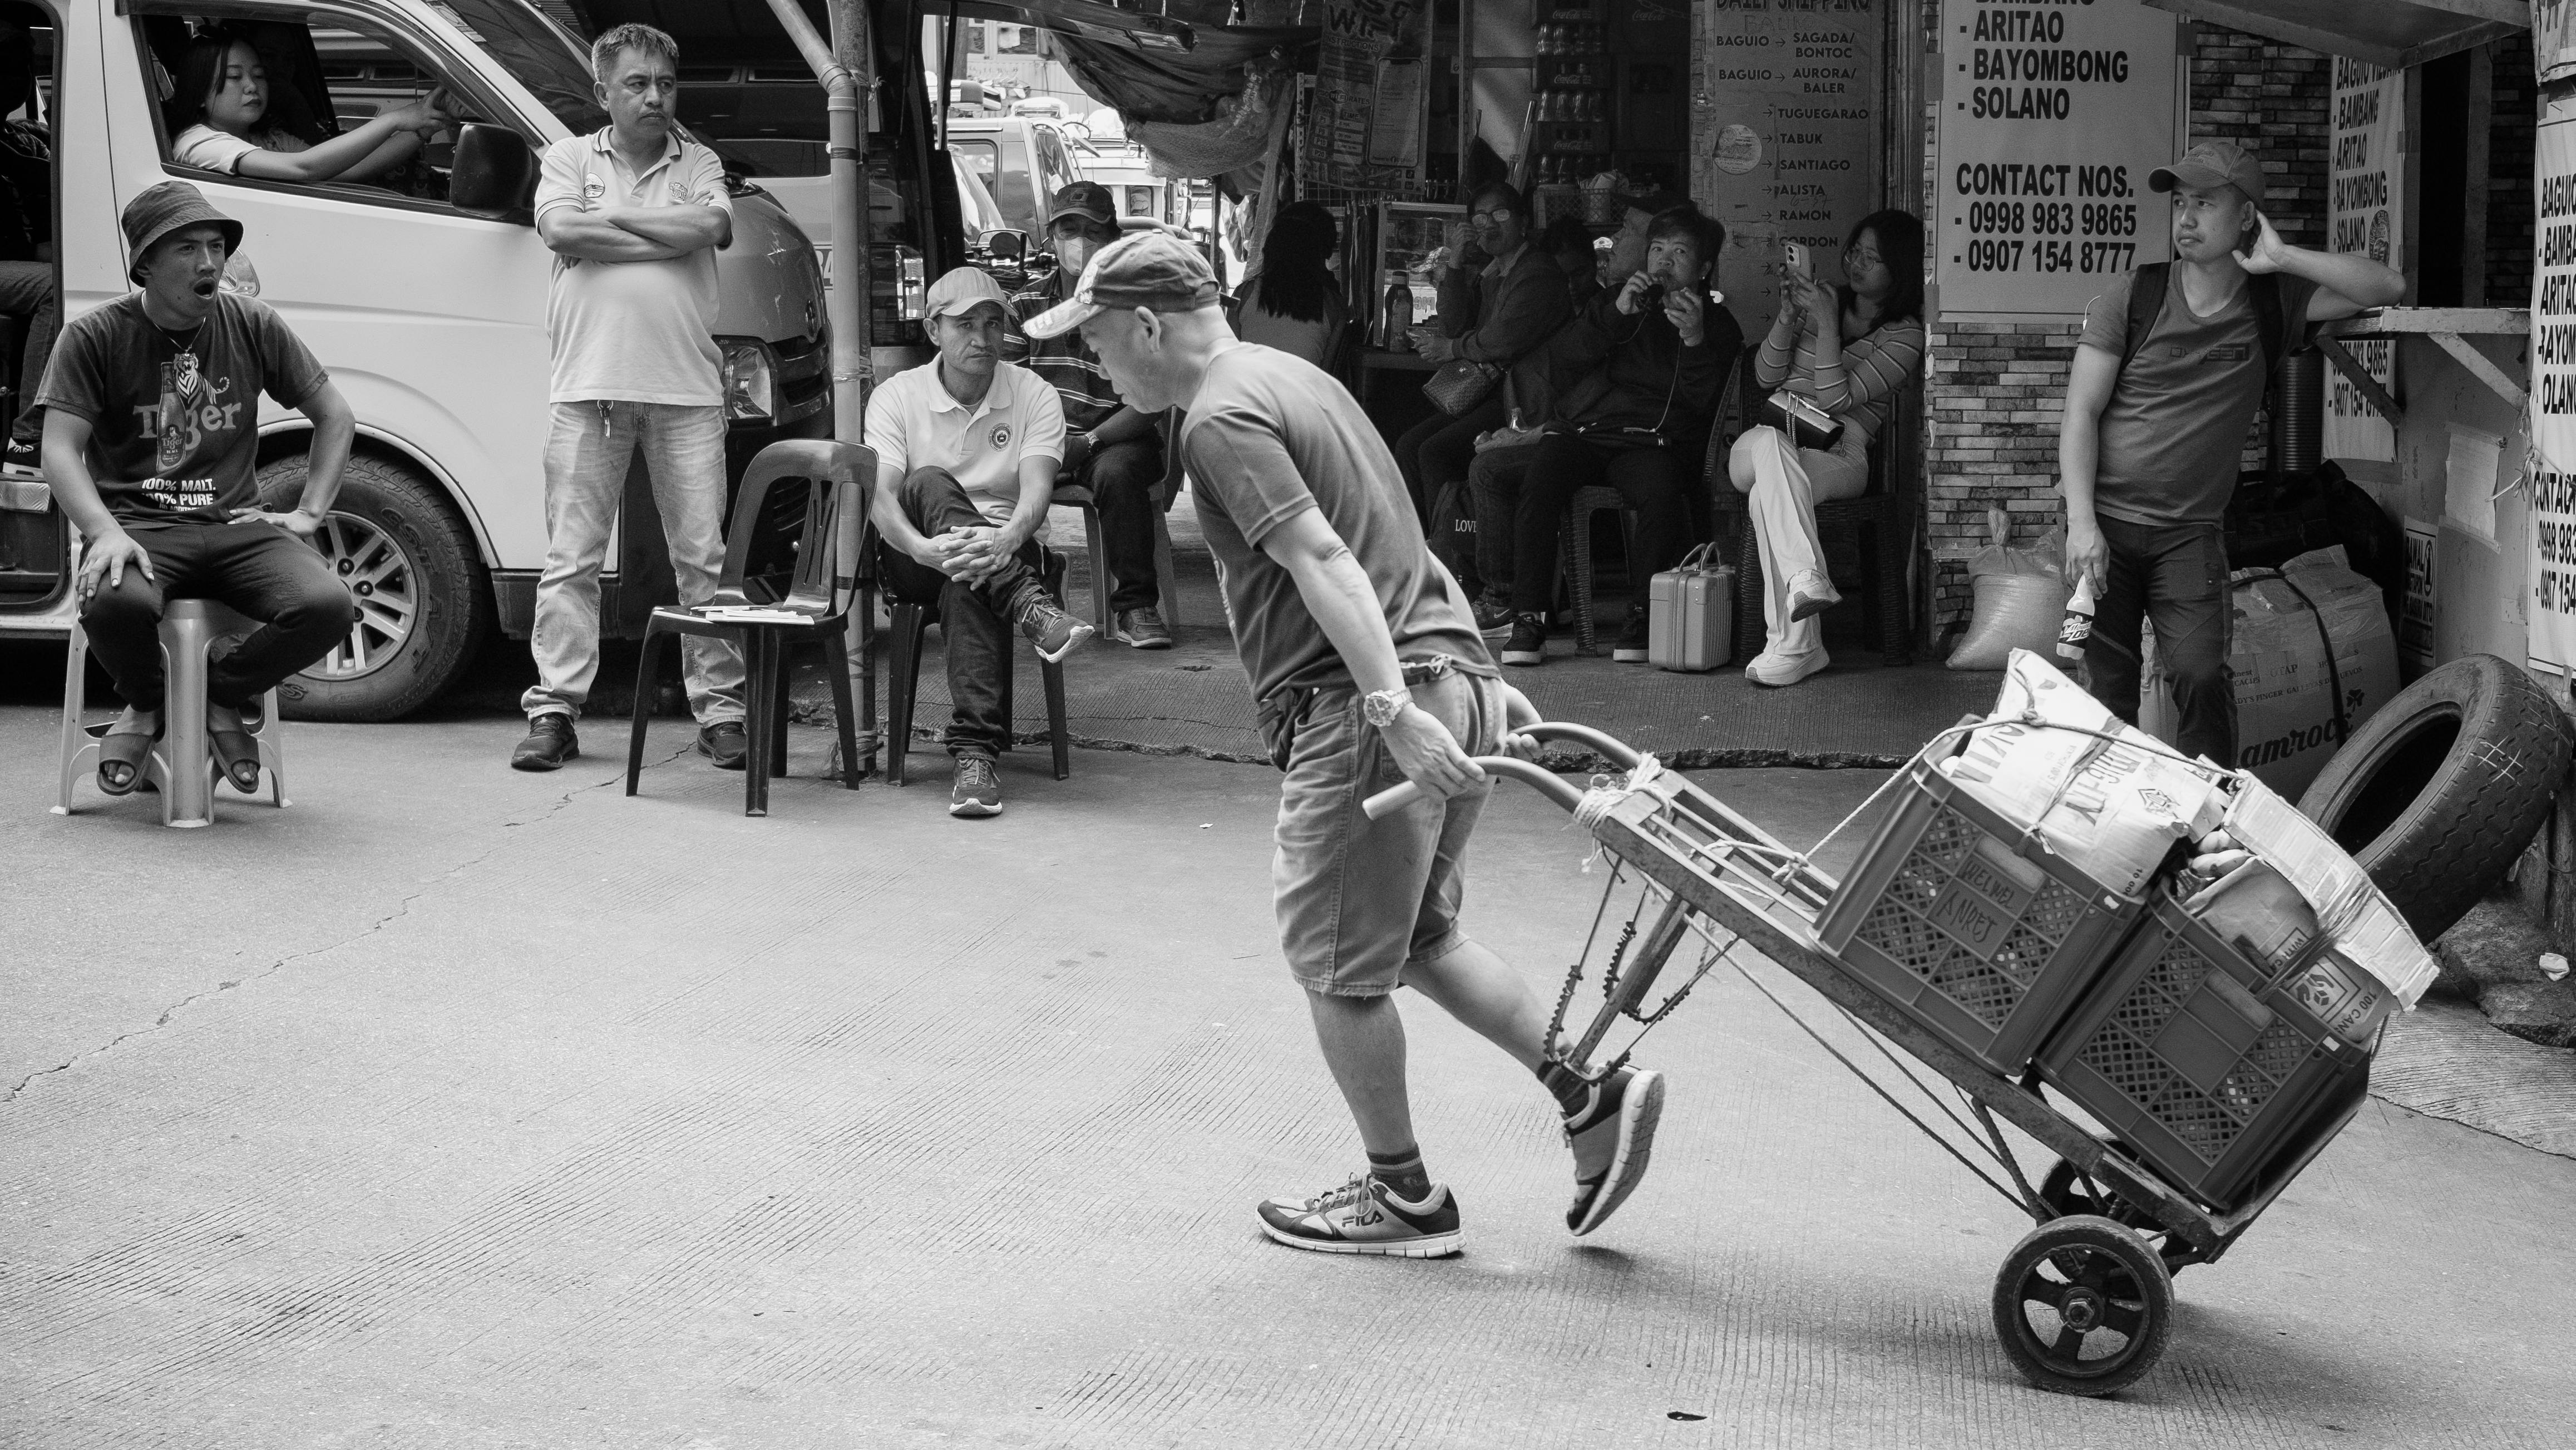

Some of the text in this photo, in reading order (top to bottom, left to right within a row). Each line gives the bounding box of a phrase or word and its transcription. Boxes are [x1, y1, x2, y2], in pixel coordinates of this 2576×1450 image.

[1716, 32, 1855, 47] BAGUIO SAGADA/
[1973, 10, 2064, 43] ARITAO
[1795, 47, 1852, 58] BONTOC
[1973, 48, 2128, 83] BAYOMBONG
[1719, 67, 1857, 81] BAGUIO AURORA/
[1349, 96, 1370, 105] RATES
[1804, 83, 1845, 94] BALER
[1778, 108, 1869, 120] TUGUEGARAO
[1972, 86, 2070, 120] SOLANO
[2338, 88, 2379, 130] BAMBANG
[1780, 133, 1823, 145] TABUK
[1780, 159, 1850, 171] SANTIAGO
[2336, 133, 2367, 172] ARITAO
[1780, 185, 1825, 195] ALISTA
[1956, 163, 2134, 198] CONTACT NOS.
[2336, 170, 2387, 213] BAYOMBONG
[1780, 210, 1831, 220] RAMON
[1969, 201, 2136, 236] 0998 983 9865
[2337, 216, 2366, 254] SOLANO
[2544, 224, 2576, 267] BAMBA
[1968, 239, 2136, 273] 0907 154 8777
[2367, 341, 2387, 376] 9865
[2543, 373, 2576, 414] OLAN
[142, 478, 216, 491] 100% MALT.
[179, 494, 213, 506] PURE
[2559, 572, 2576, 615] 154
[2234, 677, 2260, 686] CACIES
[2256, 690, 2283, 701] FINGER
[2338, 665, 2363, 679] UEVOS
[2358, 991, 2377, 1010] 100
[1341, 1210, 1385, 1227] FILA
